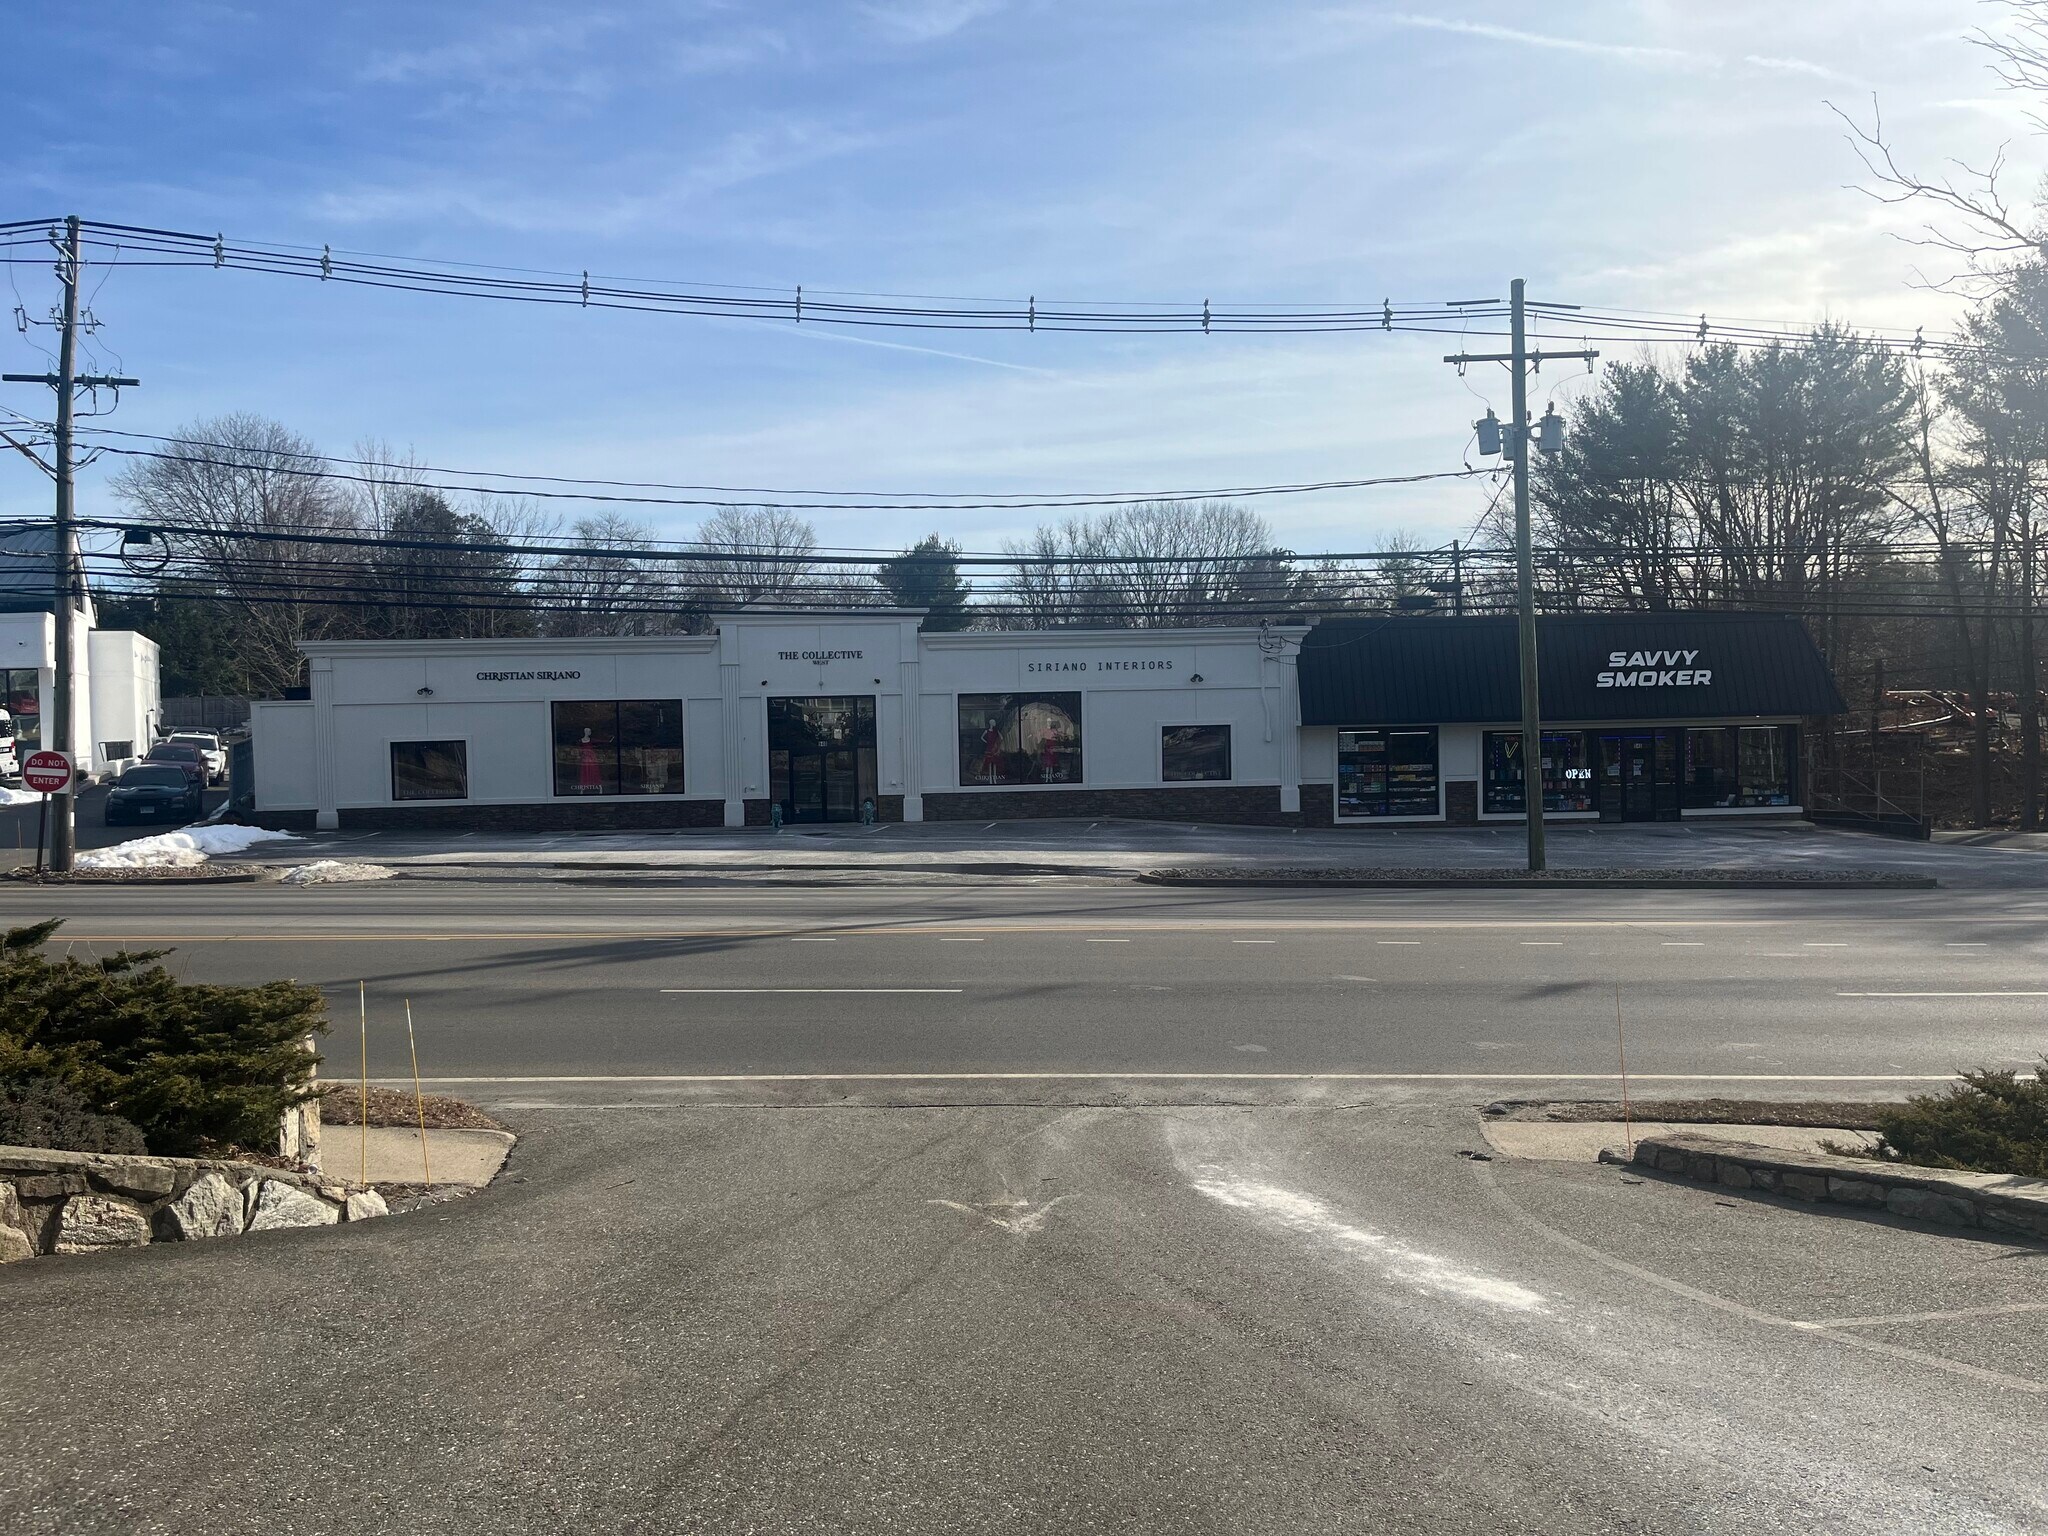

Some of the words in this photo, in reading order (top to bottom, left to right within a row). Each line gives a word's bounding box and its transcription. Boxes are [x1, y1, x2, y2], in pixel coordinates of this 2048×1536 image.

[778, 651, 799, 660] THE
[802, 650, 863, 660] COLLECTIVE
[1608, 650, 1699, 667] SAVVY
[1028, 662, 1087, 672] SIRIANO
[1098, 660, 1173, 671] INTERIORS
[476, 671, 535, 681] CHRISTIAN
[536, 670, 581, 681] SIRIANO
[1596, 669, 1712, 687] SMOKER
[31, 758, 44, 766] DO
[48, 759, 65, 767] NOT
[1565, 768, 1592, 779] OPEN
[32, 776, 60, 785] ENTER
